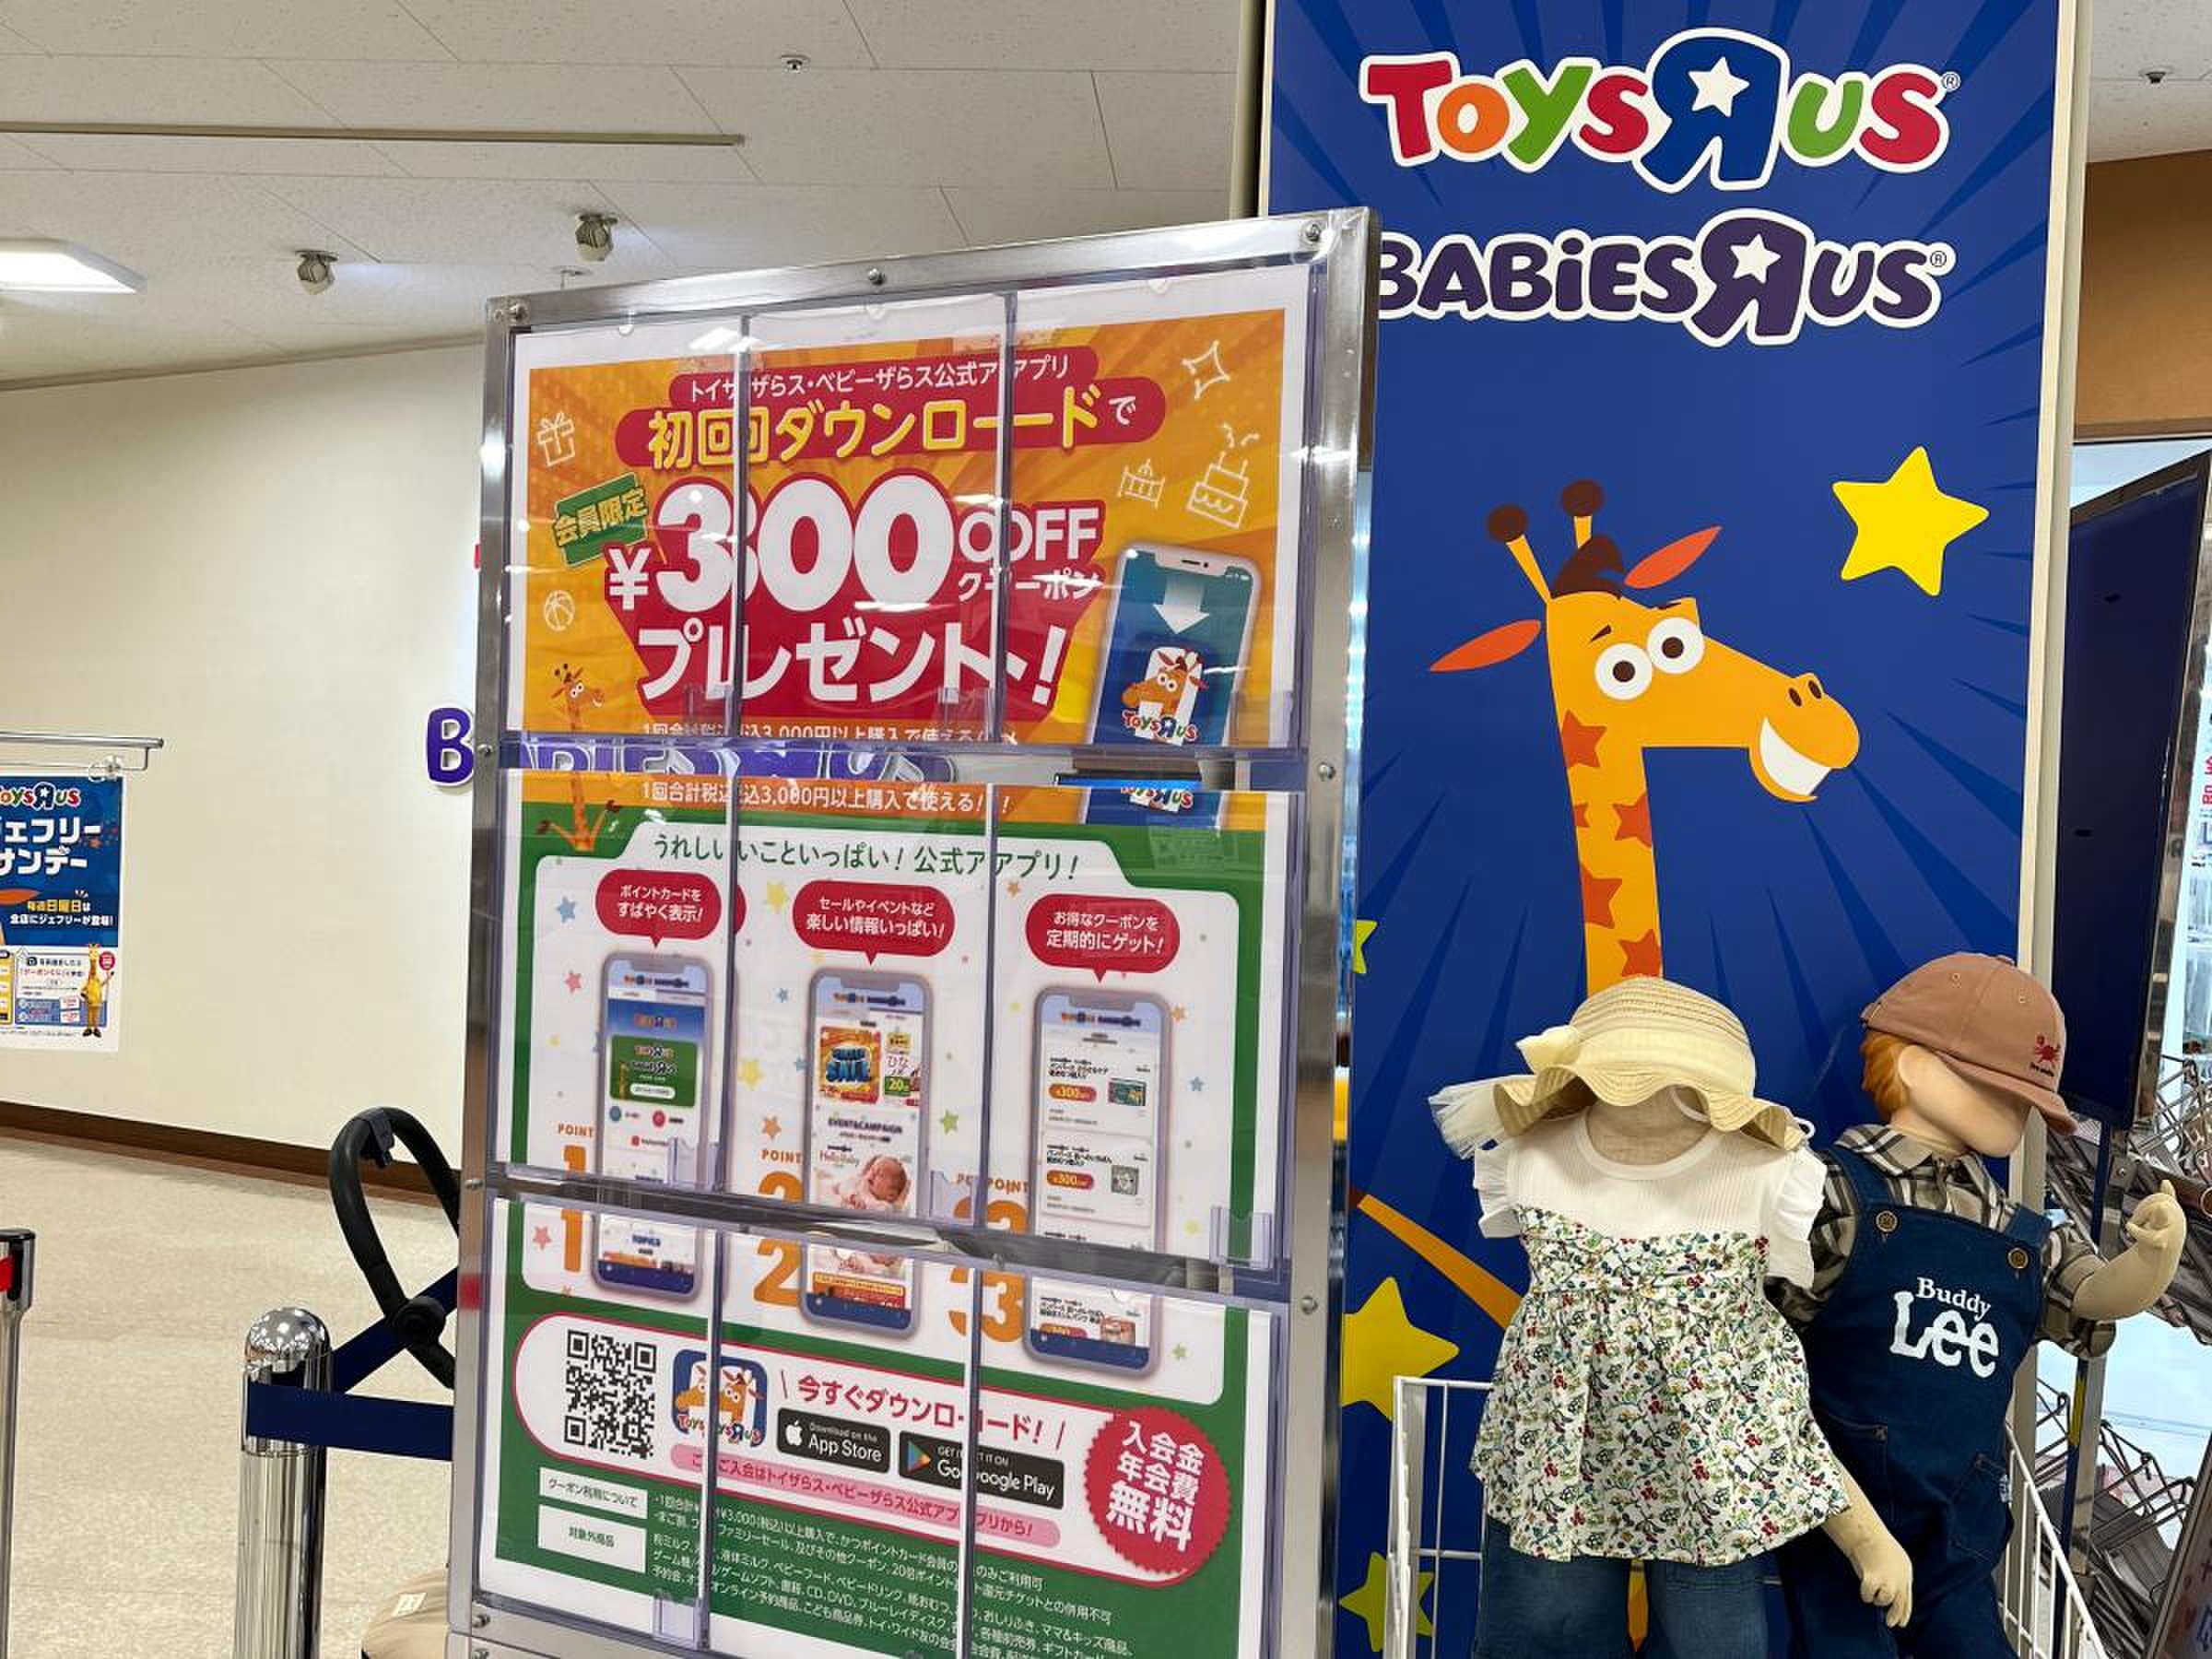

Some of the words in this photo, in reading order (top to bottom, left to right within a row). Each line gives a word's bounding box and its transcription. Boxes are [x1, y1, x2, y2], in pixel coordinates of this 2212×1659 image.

[554, 486, 648, 547] 会員限定
[0, 817, 101, 843] ェフリー
[619, 884, 702, 902] ポイントカードを
[819, 896, 935, 916] セールやイベントなど
[618, 901, 703, 923] すばやく表示！
[1053, 911, 1159, 932] お得なクーポンを
[806, 913, 945, 939] 楽しい情報いっぱい！
[1046, 929, 1165, 955] 定期的にゲット！
[558, 1124, 594, 1138] POINT
[1915, 1277, 1992, 1322] Buddy
[1889, 1290, 2000, 1379] Lee
[809, 1422, 849, 1437] Download
[807, 1434, 839, 1456] App
[840, 1438, 883, 1464] Store
[1122, 1419, 1206, 1476] 入会金
[1022, 1475, 1056, 1500] Play
[1116, 1450, 1199, 1506] 年会費
[1106, 1479, 1194, 1553] 無料
